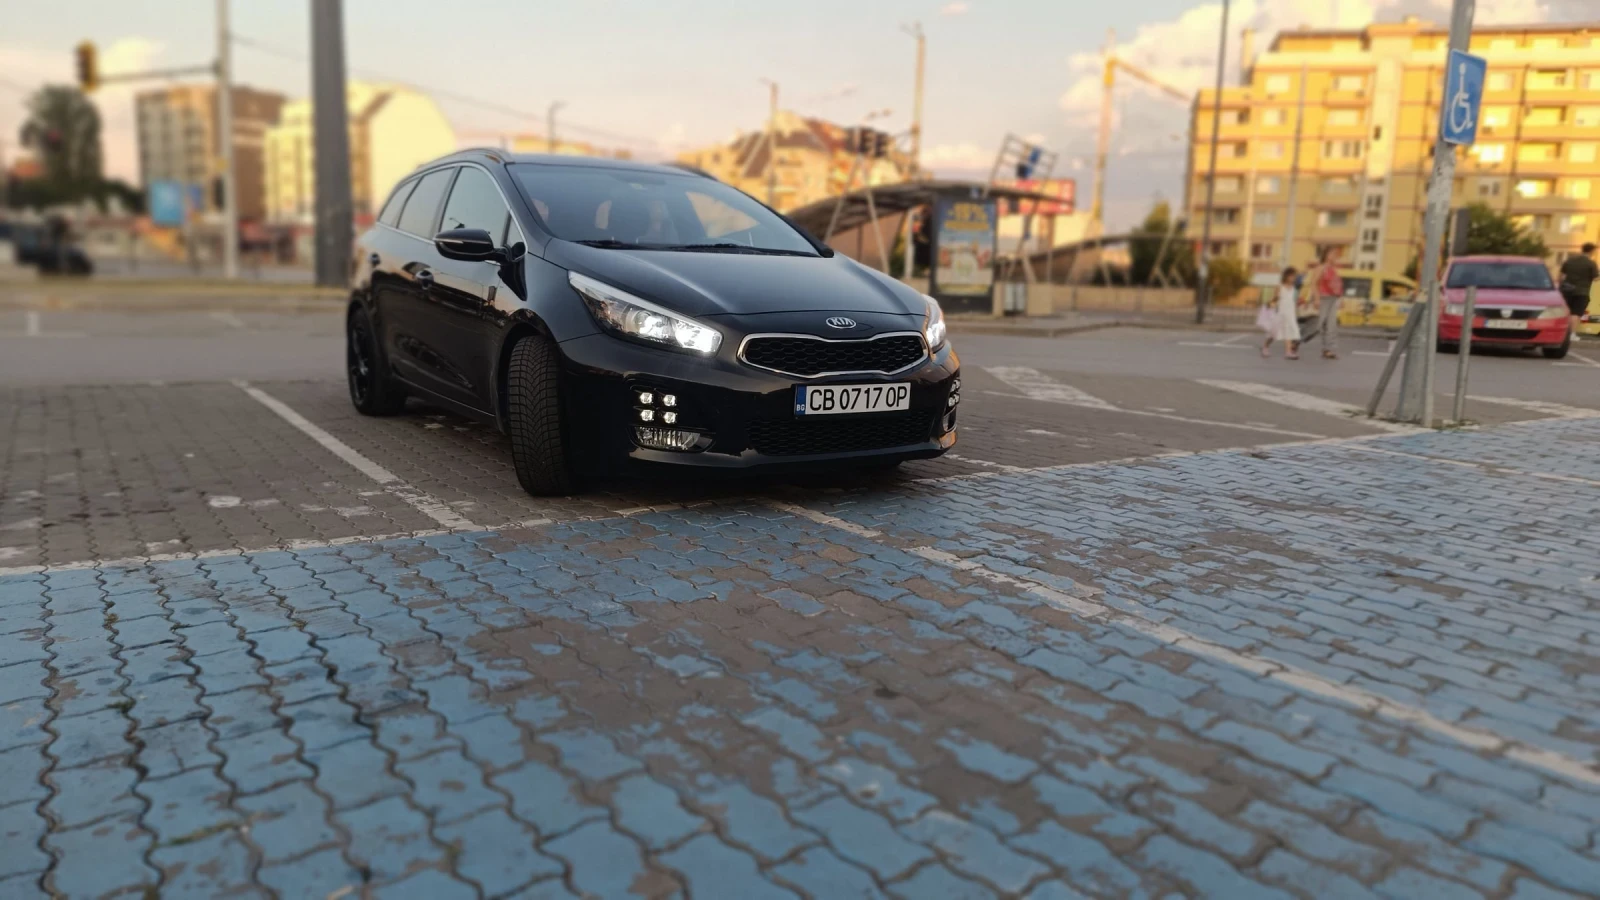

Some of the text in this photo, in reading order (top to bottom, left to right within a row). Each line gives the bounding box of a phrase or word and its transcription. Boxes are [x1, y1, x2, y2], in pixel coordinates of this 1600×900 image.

[832, 317, 853, 326] KIA
[810, 389, 834, 411] CB
[840, 387, 882, 410] 0717
